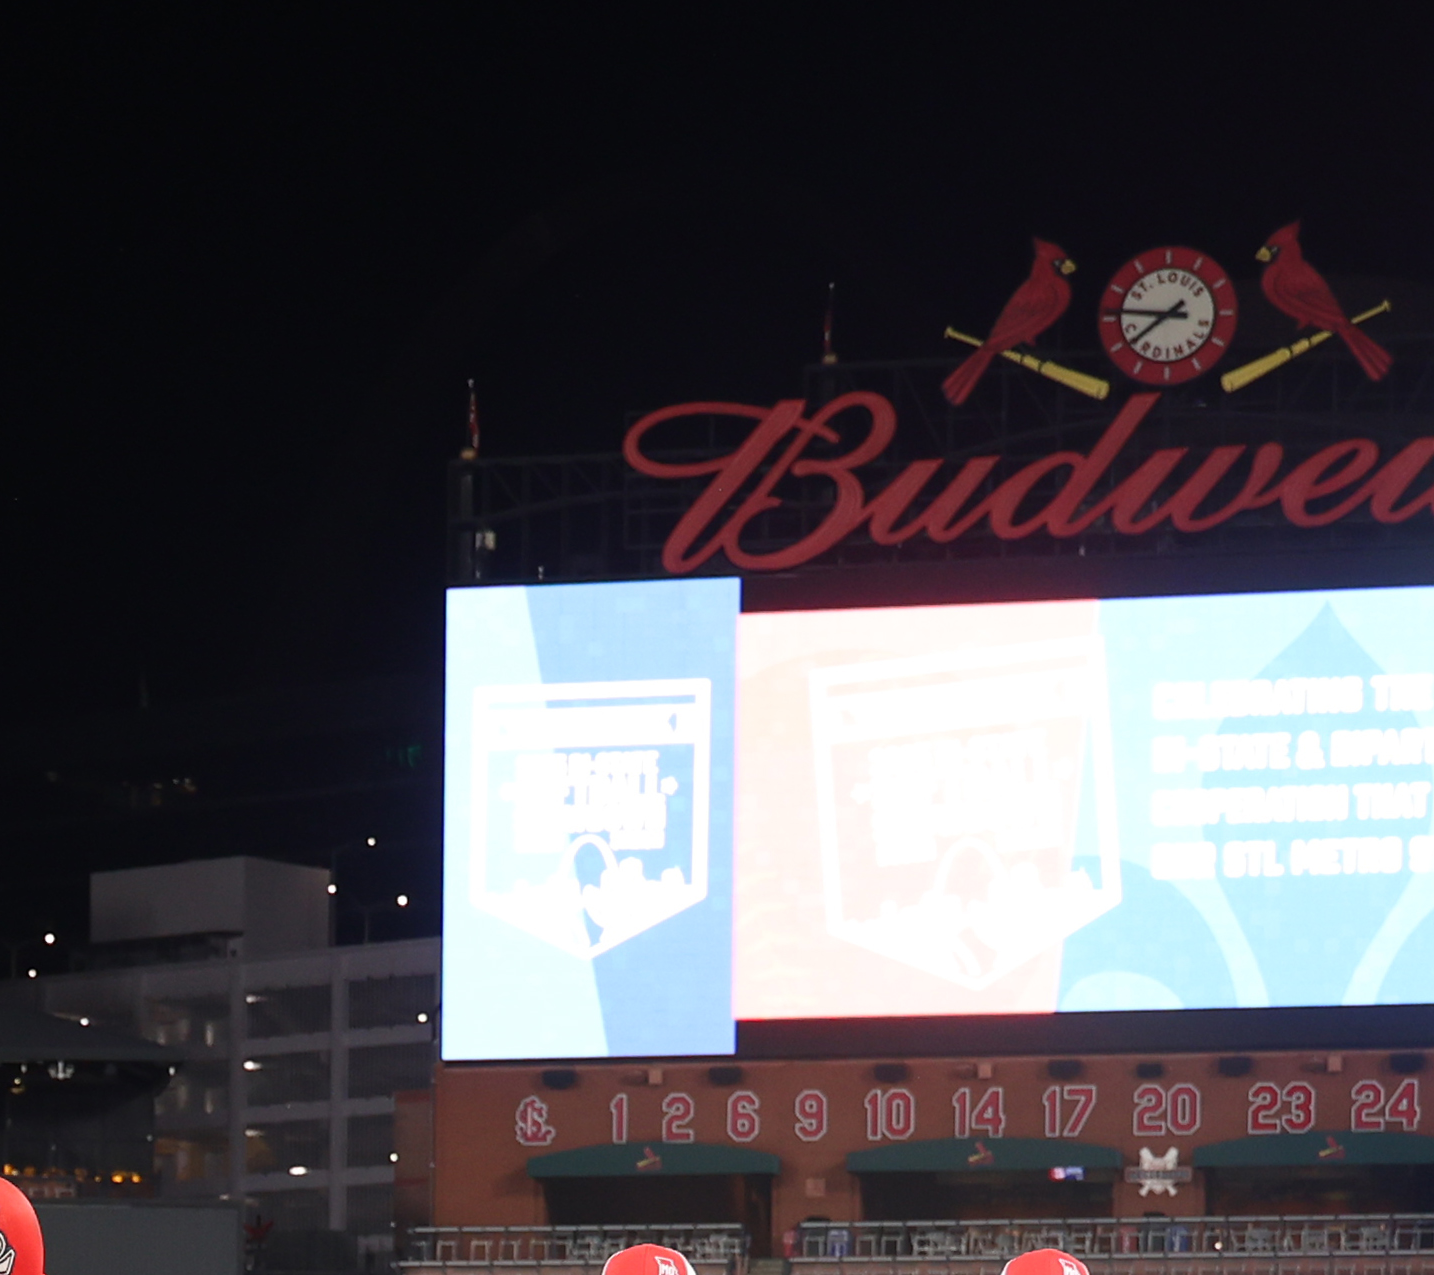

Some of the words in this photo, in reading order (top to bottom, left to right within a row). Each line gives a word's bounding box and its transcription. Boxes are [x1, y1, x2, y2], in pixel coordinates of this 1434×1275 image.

[1157, 272, 1205, 298] LOUIS
[1125, 318, 1210, 360] CRDINALS
[611, 1093, 628, 1143] 1
[661, 1092, 695, 1143] 2
[728, 1091, 761, 1142] 6
[794, 1089, 828, 1141] 9
[864, 1088, 915, 1141] 10
[953, 1087, 1006, 1139] 14
[1042, 1085, 1097, 1137] 17
[1133, 1082, 1201, 1136] 20
[1247, 1081, 1316, 1134] 23
[1351, 1079, 1421, 1132] 24
